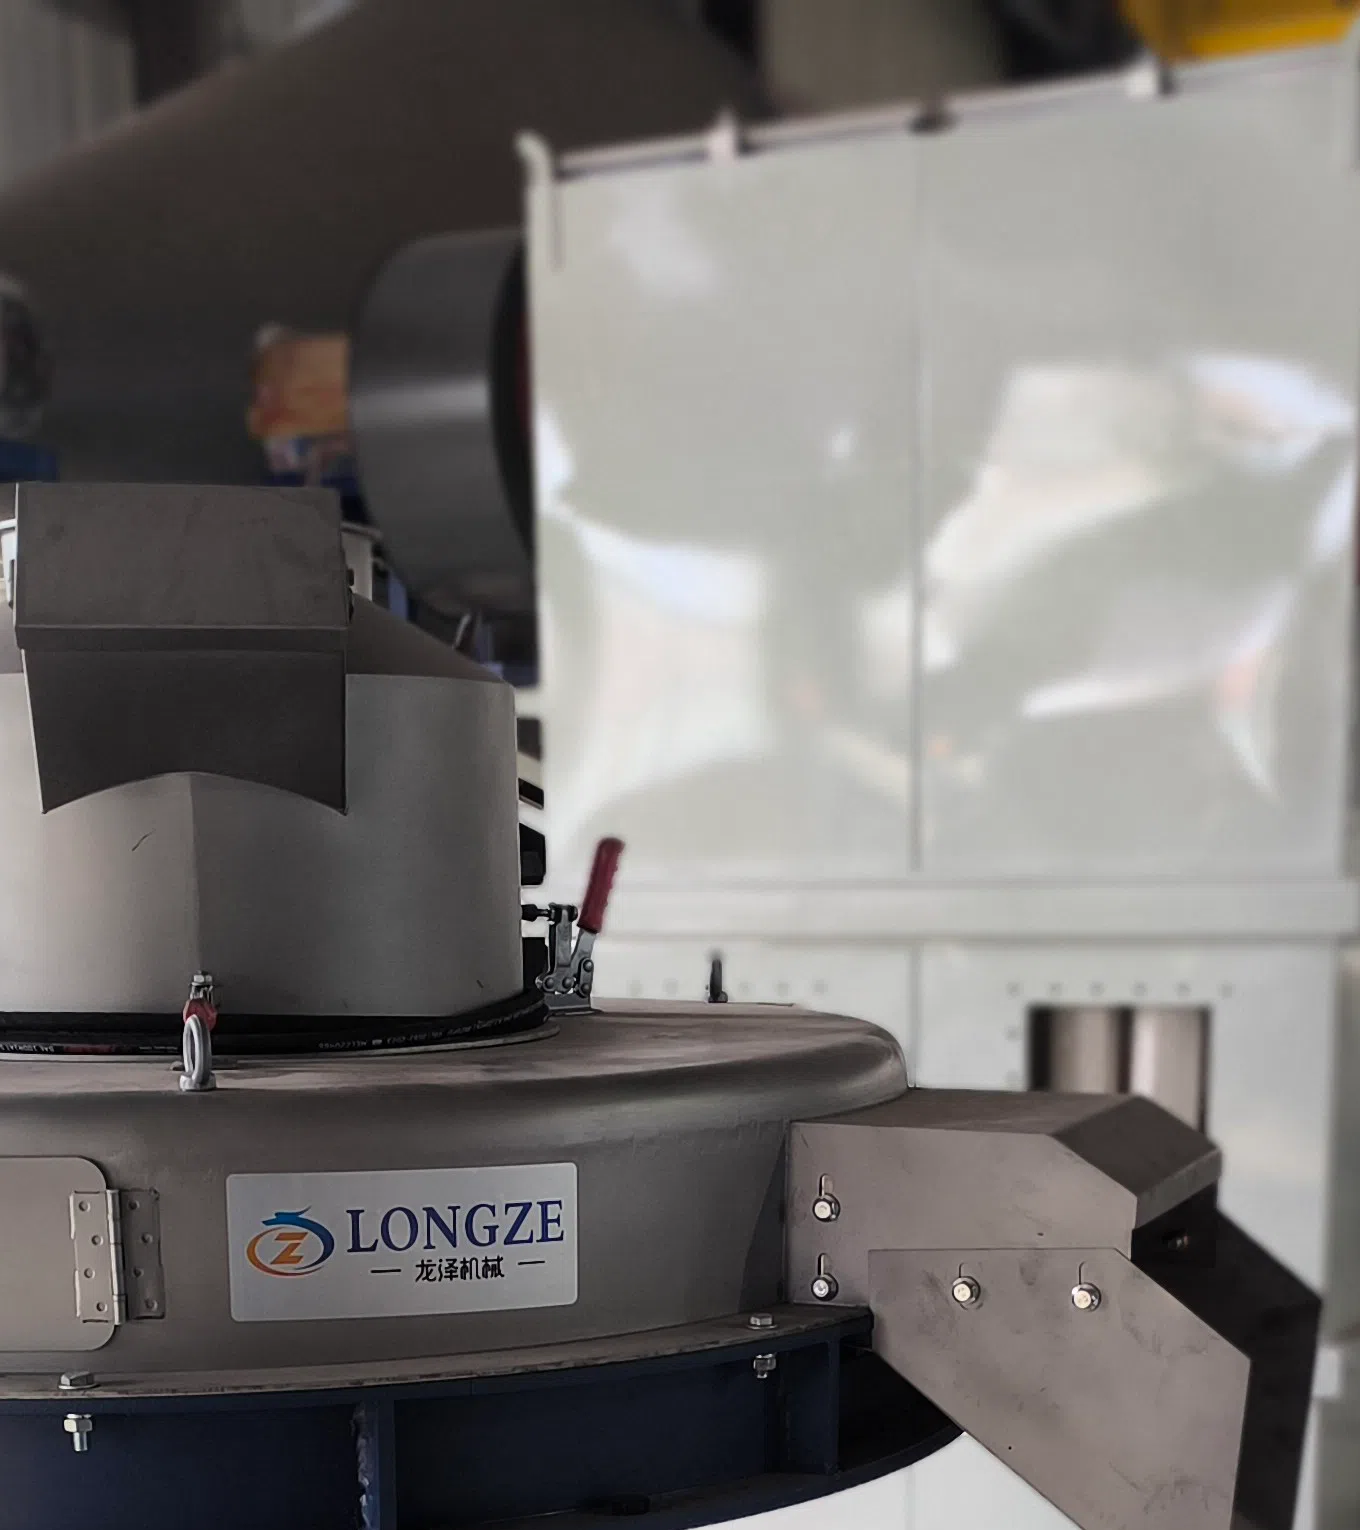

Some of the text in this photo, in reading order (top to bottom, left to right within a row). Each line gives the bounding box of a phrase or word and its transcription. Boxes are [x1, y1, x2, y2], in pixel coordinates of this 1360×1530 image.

[346, 1200, 565, 1253] LONGZE
[415, 1255, 505, 1283] 龙泽机械
